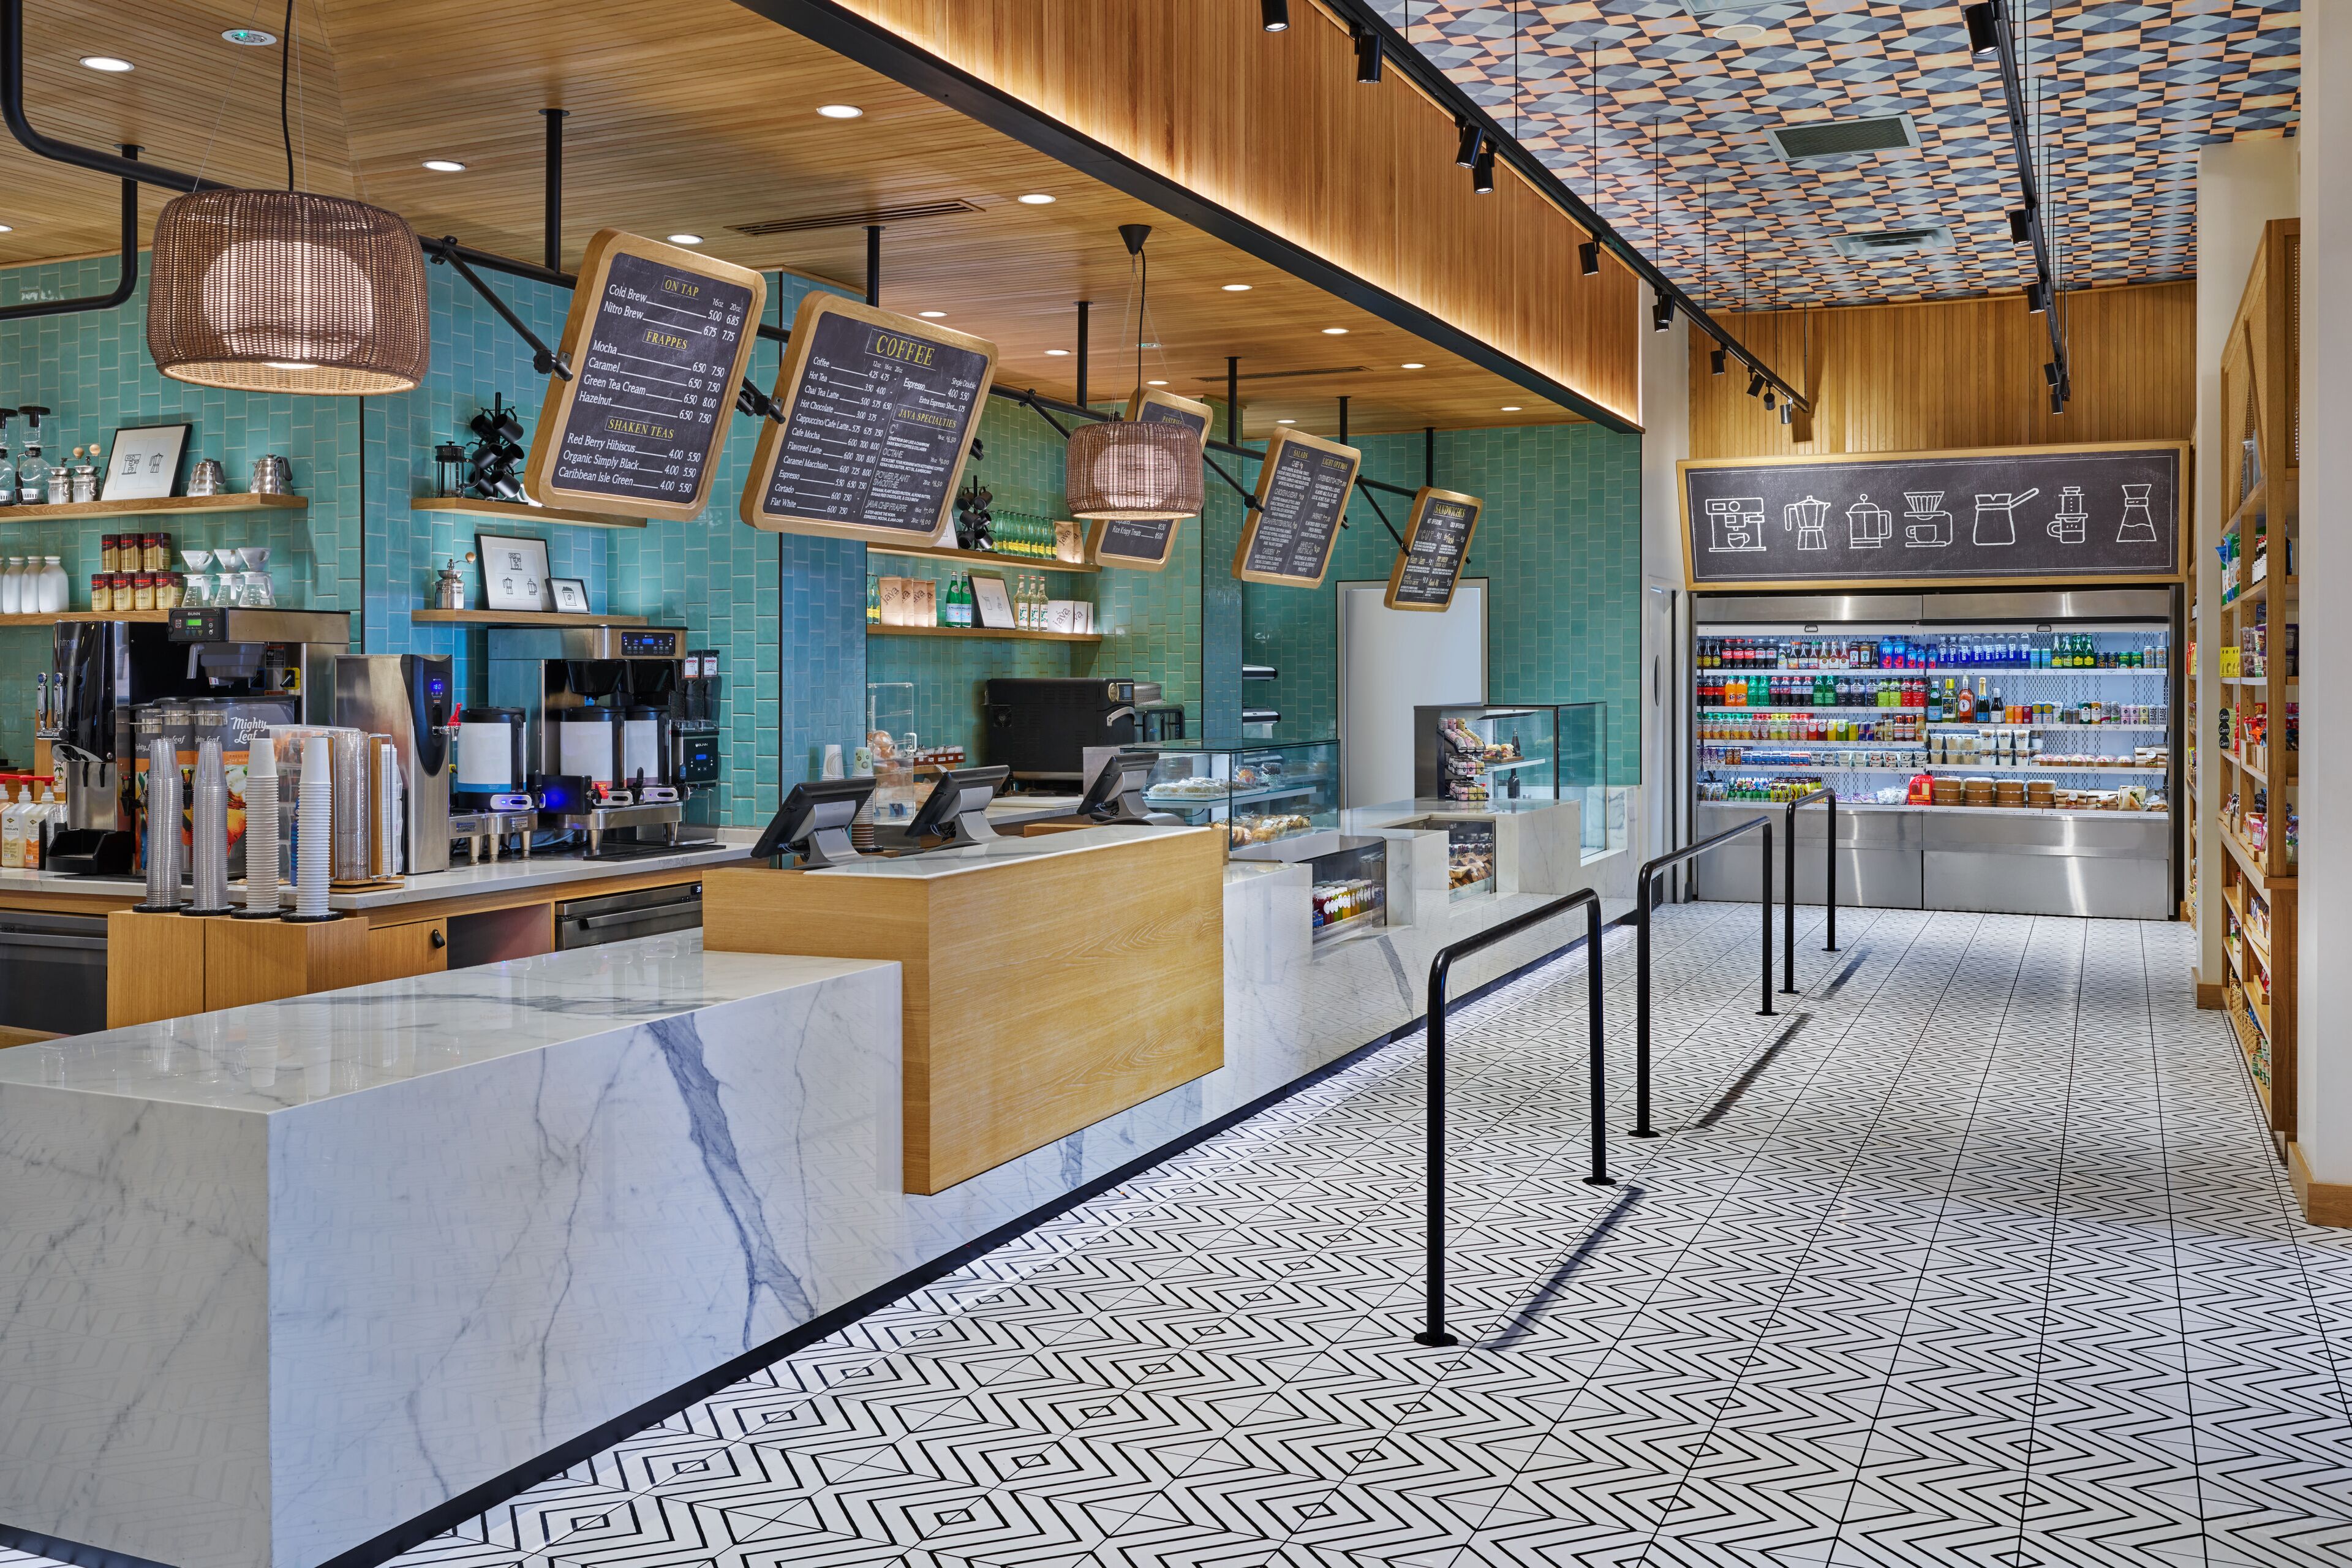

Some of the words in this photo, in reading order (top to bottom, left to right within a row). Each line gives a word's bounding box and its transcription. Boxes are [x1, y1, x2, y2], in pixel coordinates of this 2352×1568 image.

[664, 279, 677, 292] ON
[681, 284, 699, 296] TAP
[609, 284, 627, 298] Cold
[627, 288, 647, 303] Brew
[707, 309, 722, 322] 5.00
[726, 314, 740, 326] 6.85
[712, 298, 724, 308] 16oz
[729, 303, 741, 312] 20oz
[603, 300, 623, 315] Nitro
[623, 305, 644, 320] Brew
[703, 325, 718, 337] 6.75
[722, 330, 736, 342] 7.75
[646, 331, 687, 349] FRAPPES
[876, 334, 932, 365] COFFEE
[592, 339, 617, 355] Mocha
[692, 361, 707, 374] 6.50
[711, 365, 725, 377] 7.50
[813, 356, 830, 368] Coffee
[588, 356, 620, 373] Caramel
[688, 377, 702, 390] 6.50
[707, 381, 720, 393] 7.50
[808, 371, 818, 380] Hot
[818, 372, 827, 382] Tea
[903, 377, 925, 391] Espresso
[951, 377, 963, 386] Single
[962, 379, 976, 390] Double
[584, 374, 606, 388] Green
[608, 378, 621, 391] Tea
[622, 381, 646, 395] Cream
[684, 393, 698, 405] 6.50
[702, 397, 717, 409] 8.00
[804, 385, 817, 395] Chai
[817, 387, 826, 397] Tea
[826, 389, 839, 399] Latte
[578, 390, 612, 406] Hazelnut
[679, 409, 693, 421] 6.50
[698, 412, 712, 424] 7.50
[799, 399, 810, 408] Hot
[810, 401, 834, 413] Chocolate
[918, 396, 930, 405] Extra
[929, 398, 946, 409] Espresso
[945, 402, 955, 410] Shot
[796, 413, 837, 428] Cappuccino/Cafe
[835, 421, 849, 431] Latte
[899, 410, 916, 419] JAVA
[918, 413, 955, 428] SPECIALTIES
[608, 420, 647, 433] SHAKEN
[651, 426, 673, 439] TEAS
[791, 427, 804, 437] Cafe
[804, 429, 820, 440] Mocha
[567, 432, 584, 445] Red
[584, 435, 606, 451] Berry
[606, 439, 636, 453] Hibiscus
[668, 448, 684, 460] 4.00
[687, 451, 701, 462] 5.50
[787, 441, 810, 452] Flavored
[809, 445, 823, 454] Latte
[882, 447, 904, 459] OCTANE
[1293, 449, 1308, 459] SALADS
[563, 450, 593, 464] Organic
[593, 454, 619, 470] Simply
[619, 458, 639, 470] Black
[664, 464, 679, 475] 4.00
[682, 467, 696, 478] 5.50
[783, 455, 805, 466] Caramel
[804, 459, 829, 470] Macchiato
[1322, 458, 1333, 467] LIGHT
[558, 466, 597, 481] Caribbean
[597, 472, 611, 483] Isle
[611, 473, 633, 486] Green
[660, 480, 675, 491] 4.00
[678, 482, 692, 493] 5.50
[778, 469, 800, 480] Espresso
[774, 483, 794, 494] Cortado
[770, 497, 784, 506] Flat
[782, 499, 797, 508] White
[865, 499, 878, 508] JAVA
[878, 501, 890, 510] CHIP
[888, 502, 908, 512] FRAPPE
[1434, 503, 1466, 518] SANDWICHES
[1057, 529, 1072, 546] java
[1120, 527, 1131, 536] Krispy
[881, 587, 899, 606] java
[1053, 608, 1071, 628] java
[230, 717, 267, 732] Mighty
[234, 729, 257, 744] Leaf
